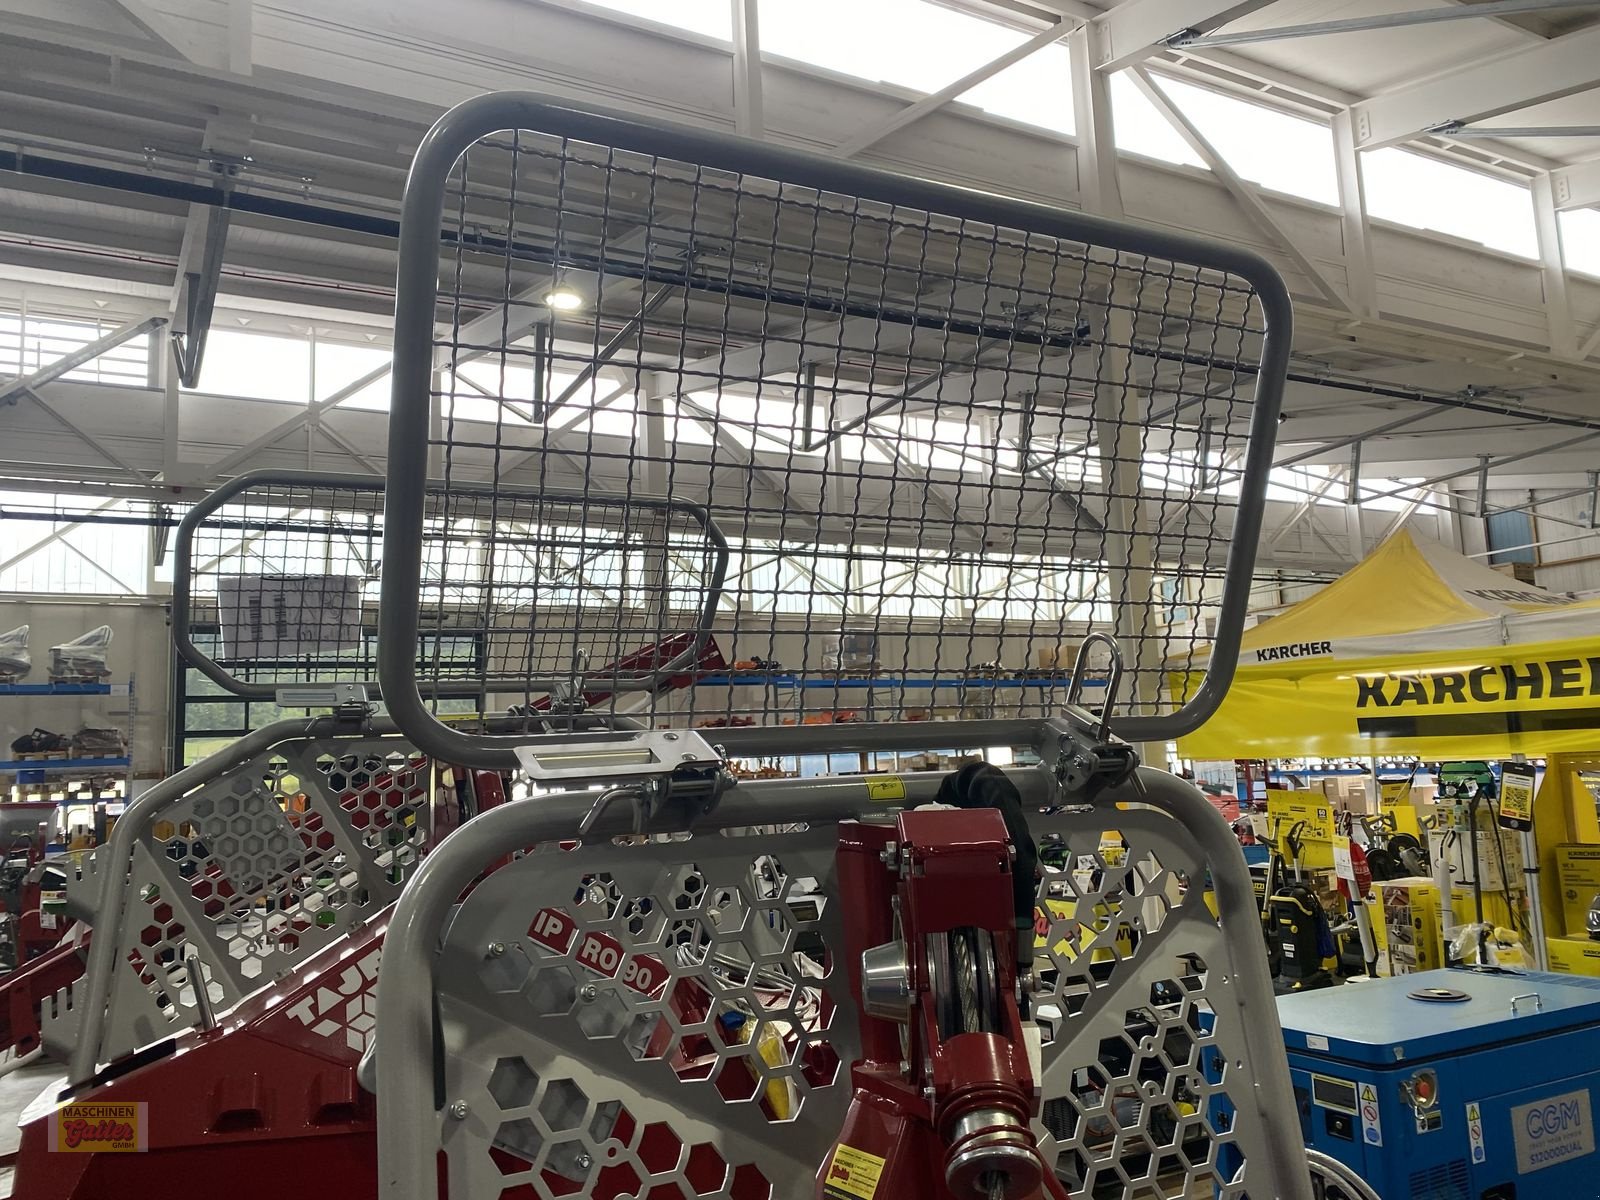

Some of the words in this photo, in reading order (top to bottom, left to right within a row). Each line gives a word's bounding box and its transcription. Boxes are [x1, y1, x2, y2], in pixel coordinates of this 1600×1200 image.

[1256, 641, 1333, 662] KÄRCHER
[534, 911, 563, 938] IP
[624, 960, 652, 990] 90
[1526, 1098, 1581, 1139] CGM
